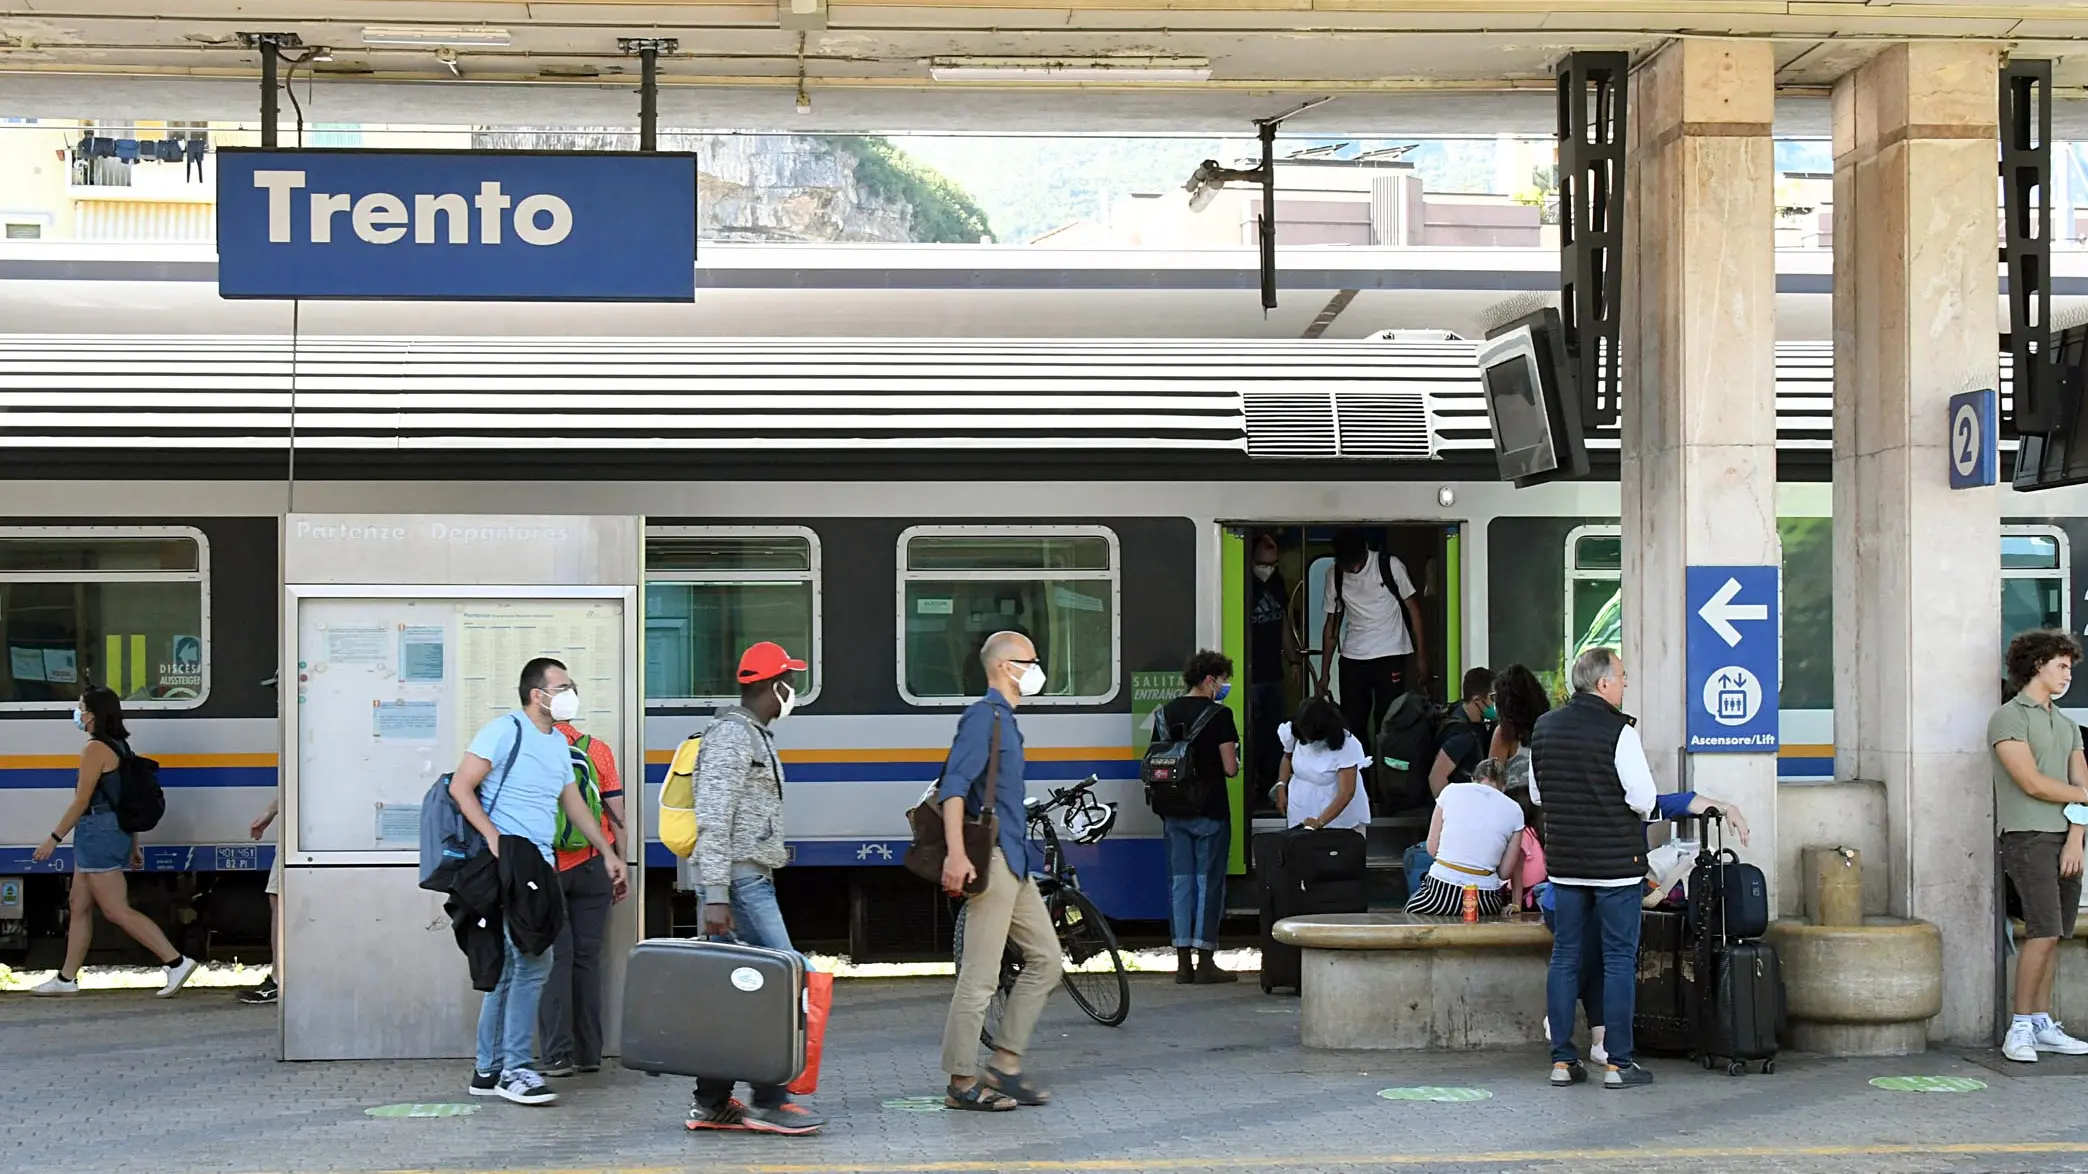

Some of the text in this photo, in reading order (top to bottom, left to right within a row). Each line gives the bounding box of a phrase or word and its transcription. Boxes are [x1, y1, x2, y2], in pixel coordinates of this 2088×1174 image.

[254, 170, 573, 245] Trento
[1958, 416, 1972, 463] 2
[297, 521, 567, 544] Partenze Departures
[1133, 675, 1185, 687] SALITA
[1691, 734, 1775, 745] Ascensore/Lift
